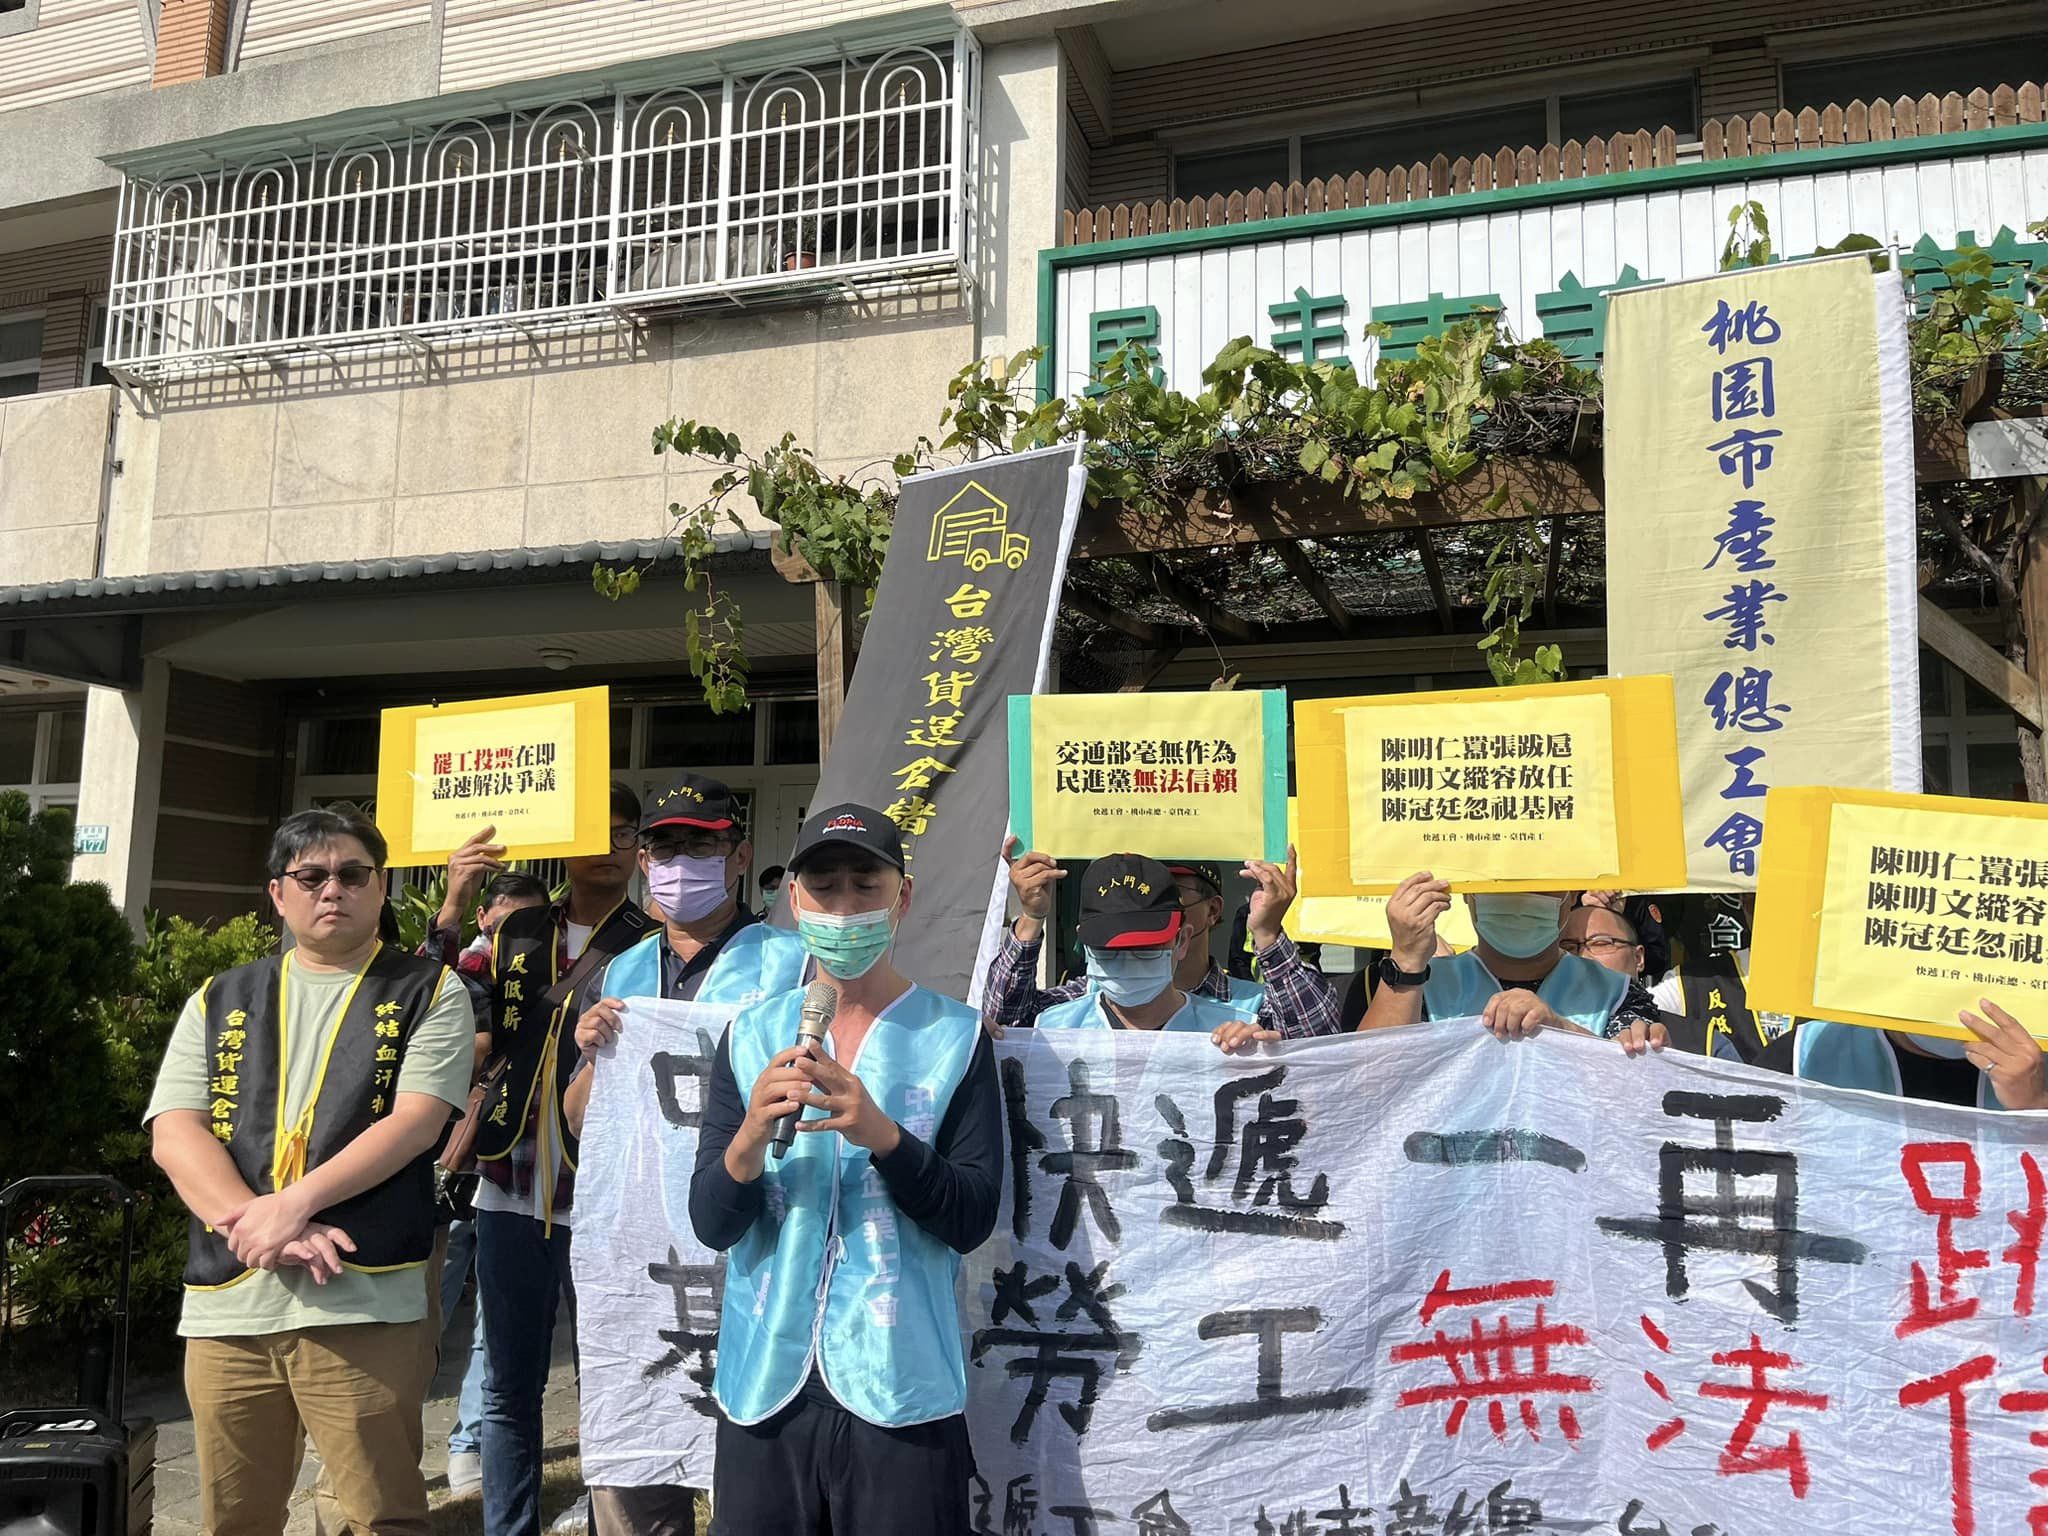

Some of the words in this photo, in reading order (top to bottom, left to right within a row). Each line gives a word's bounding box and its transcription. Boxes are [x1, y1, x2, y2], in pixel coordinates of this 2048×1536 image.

[1702, 299, 1792, 877] 桃園市產業總工會
[882, 583, 995, 880] 台灣貨運倉儲
[1380, 733, 1573, 763] 陳明仁囂張跋扈
[432, 742, 556, 776] 罷工投票在即
[1055, 739, 1238, 766] 交通部毫無作為
[431, 767, 556, 800] 盡速解決爭議
[1055, 767, 1239, 794] 民進黨無法信賴
[1380, 763, 1574, 793] 陳明文縱容放任
[1381, 794, 1575, 823] 陳冠廷忽視基層
[1869, 844, 2048, 890] 陳明仁囂張
[1866, 881, 2048, 927] 陳明文縱容
[1863, 916, 2048, 965] 陳冠廷忽視
[370, 1000, 403, 1127] 終結血汗物
